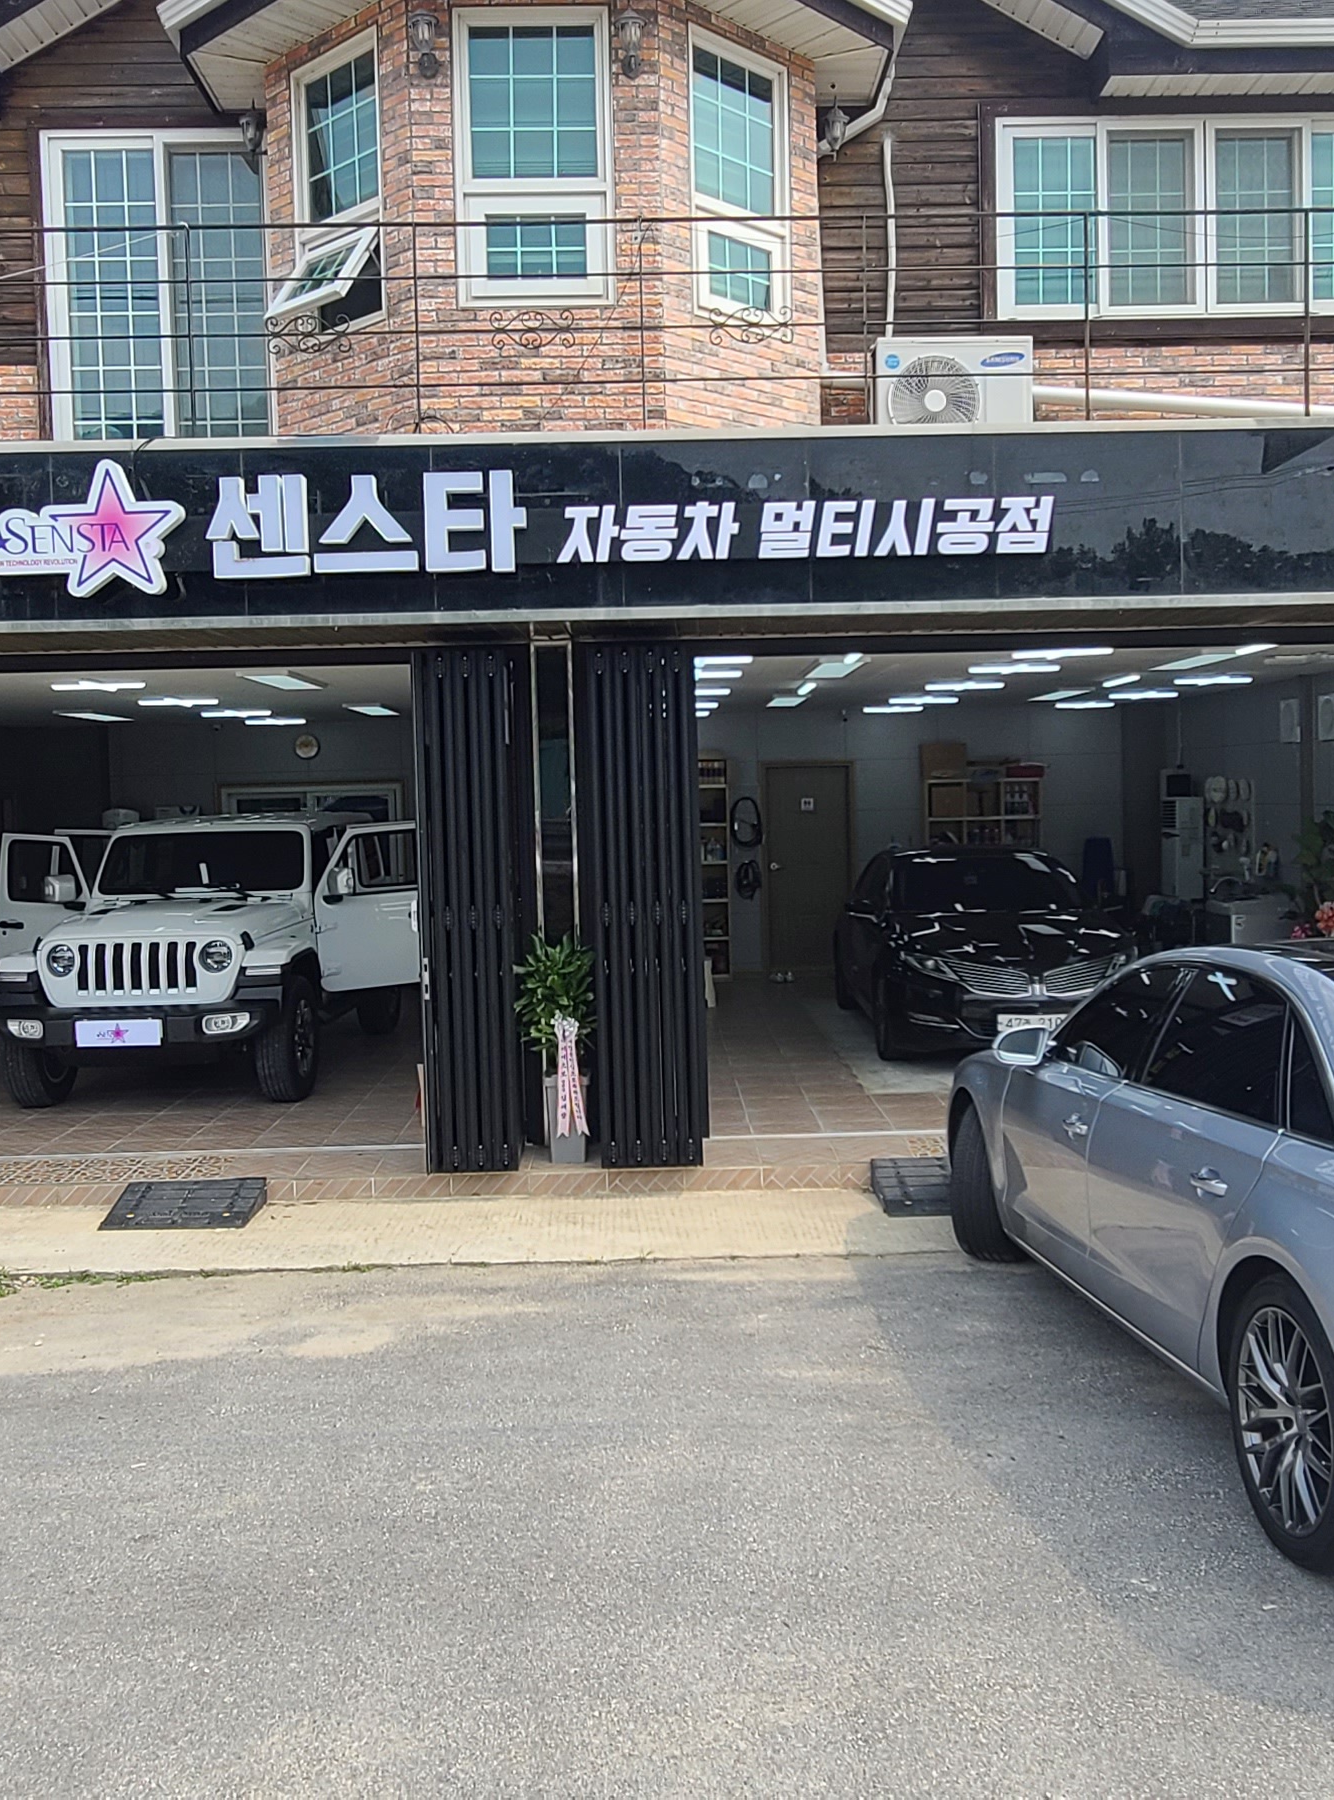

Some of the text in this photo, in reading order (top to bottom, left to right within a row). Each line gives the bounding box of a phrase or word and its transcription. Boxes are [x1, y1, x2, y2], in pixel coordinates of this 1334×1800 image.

[5, 517, 130, 555] SENSTA
[206, 469, 1056, 579] 센스타 자동차 멀티시공점
